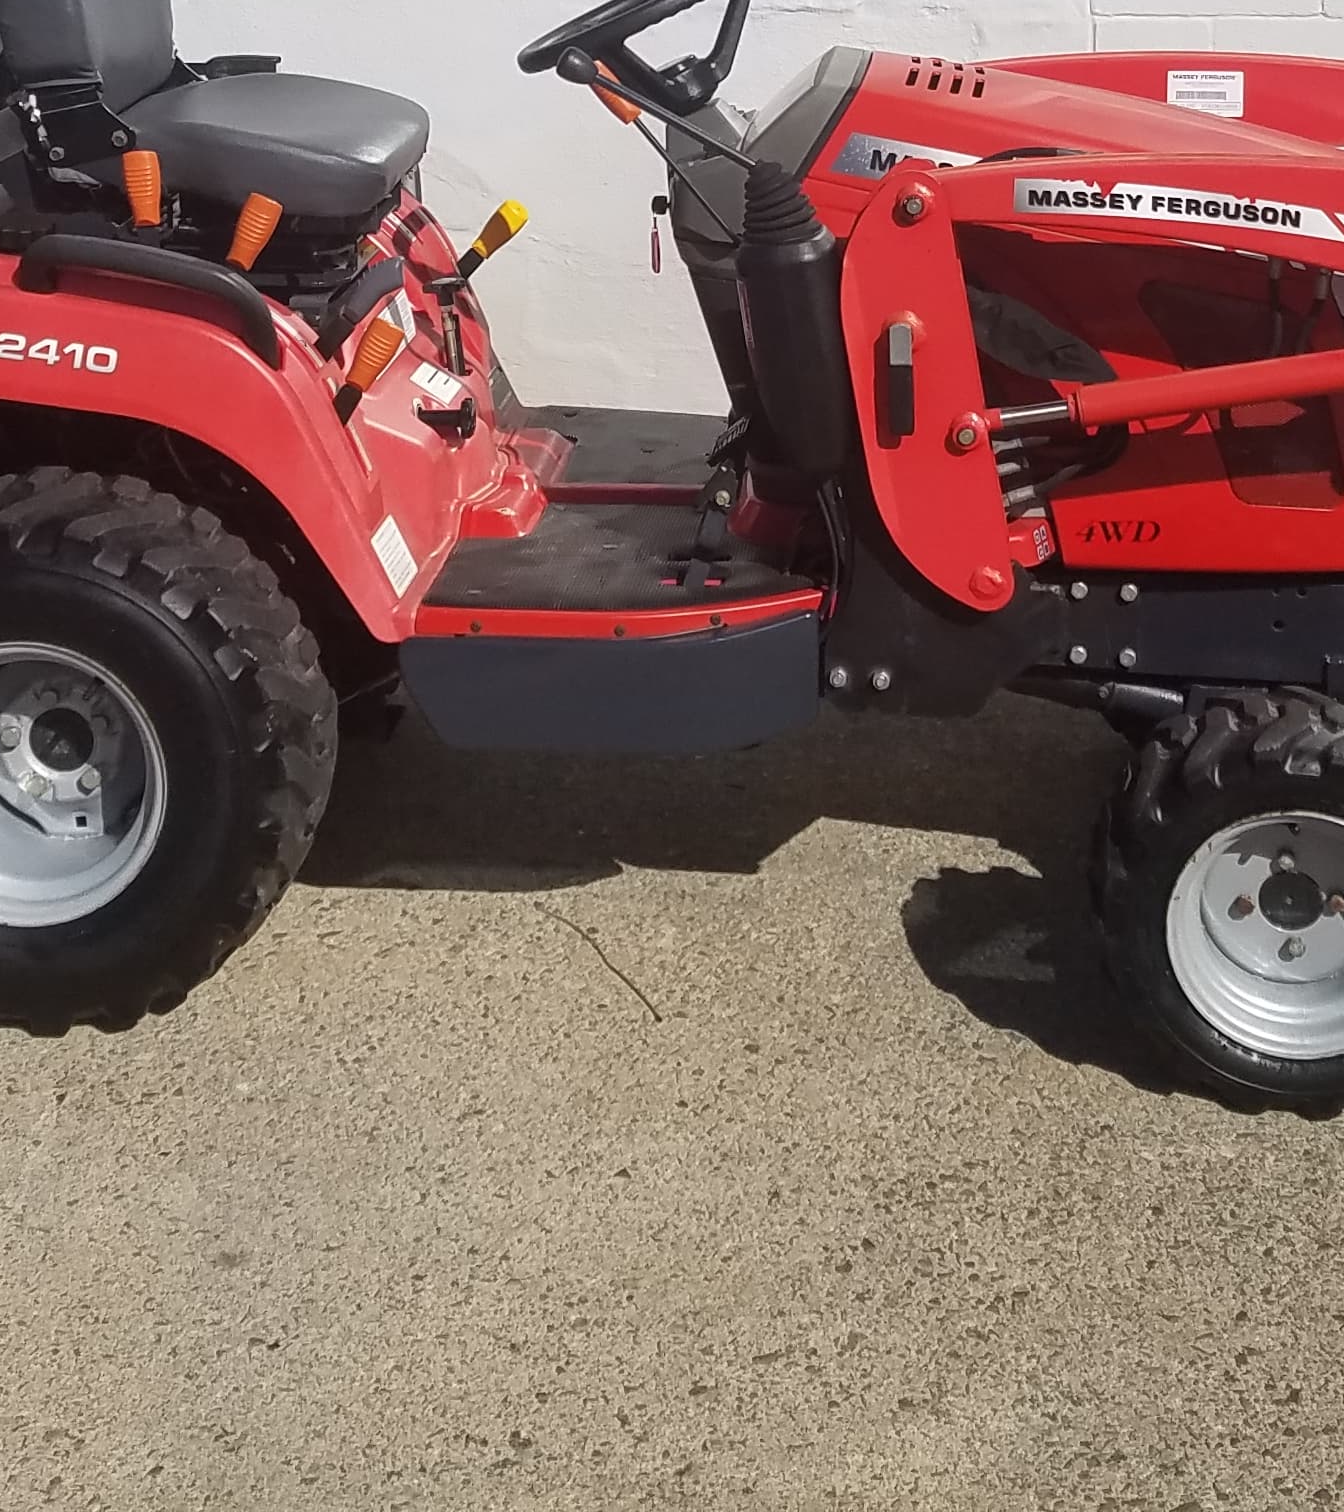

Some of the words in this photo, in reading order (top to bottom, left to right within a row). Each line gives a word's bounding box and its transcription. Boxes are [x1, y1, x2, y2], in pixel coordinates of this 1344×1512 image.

[1027, 189, 1143, 212] MASSEY
[1151, 194, 1301, 228] FERGUSON
[1074, 521, 1161, 543] 4WD
